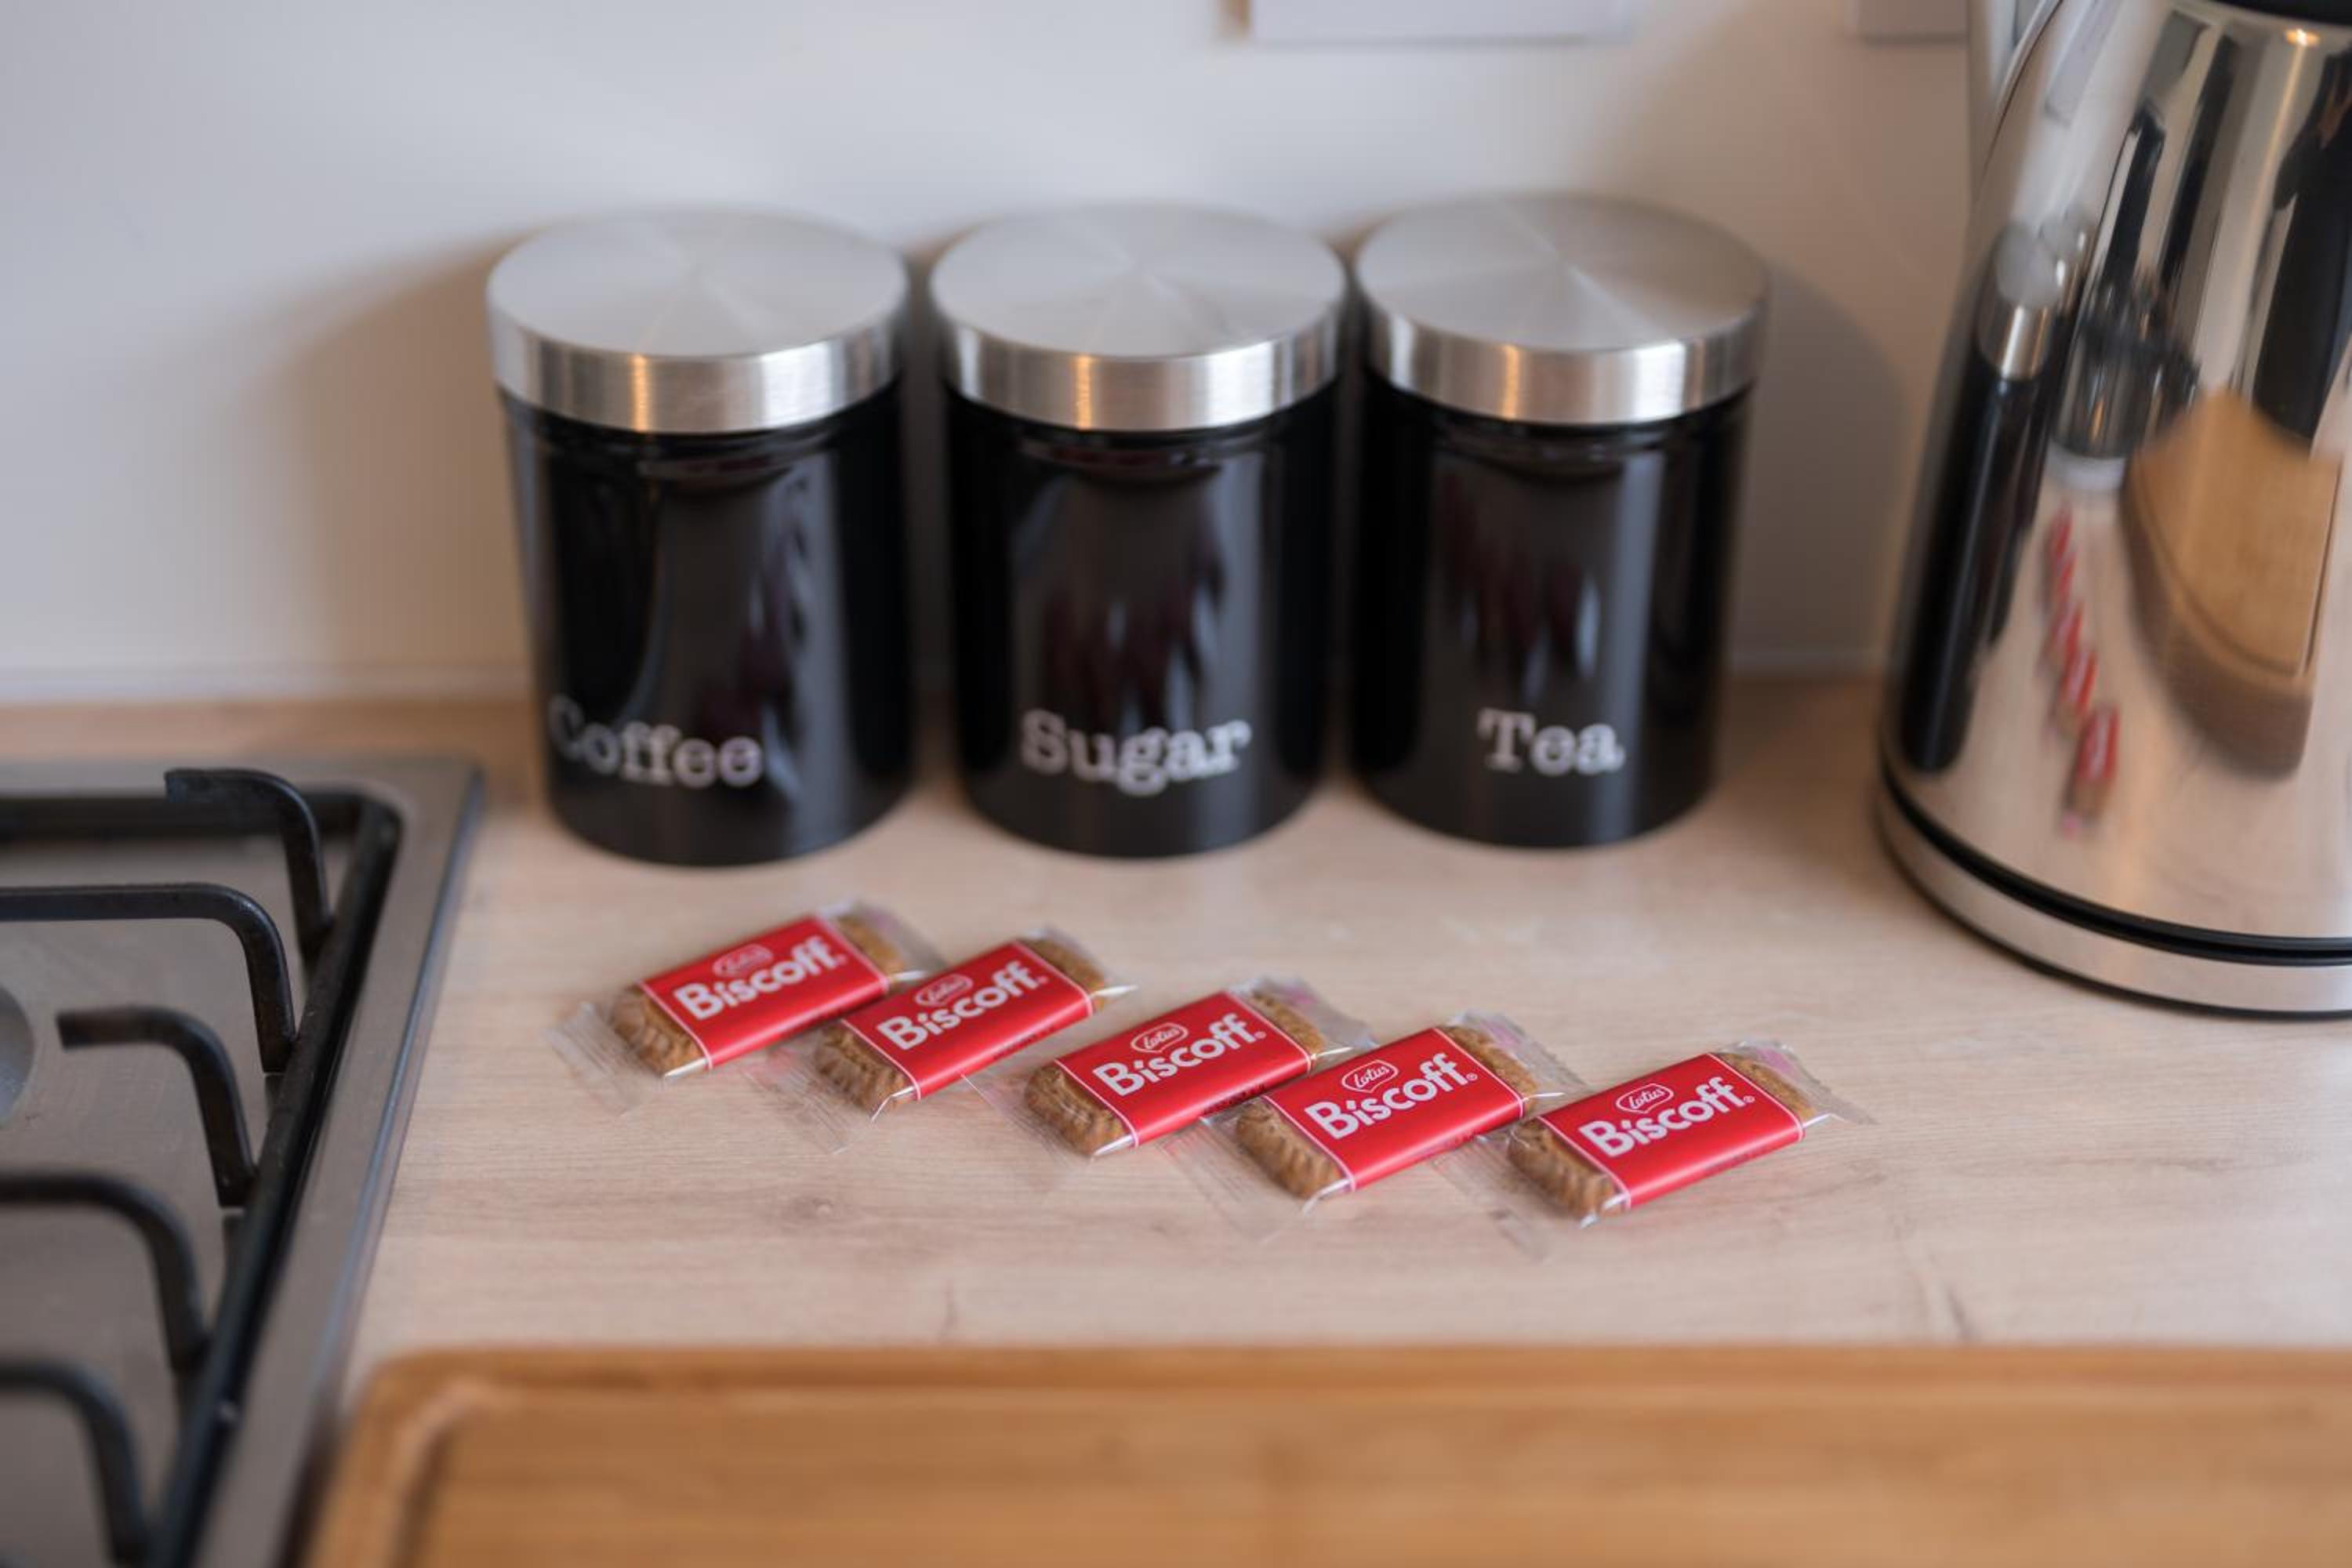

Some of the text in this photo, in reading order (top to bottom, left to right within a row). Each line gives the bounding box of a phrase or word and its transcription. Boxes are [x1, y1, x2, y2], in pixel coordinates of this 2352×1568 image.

[550, 693, 762, 787] Coffee
[1022, 708, 1252, 797] Sugar
[1476, 706, 1626, 775] Tea
[673, 936, 837, 1020] Biscoff
[876, 960, 1039, 1051] Biscoff
[1092, 1012, 1257, 1096] Biscoff
[1353, 1064, 1391, 1088] Lotus
[1304, 1053, 1468, 1140] Biscoff
[1578, 1076, 1745, 1158] Biscoff
[1628, 1086, 1666, 1109] Lotus
